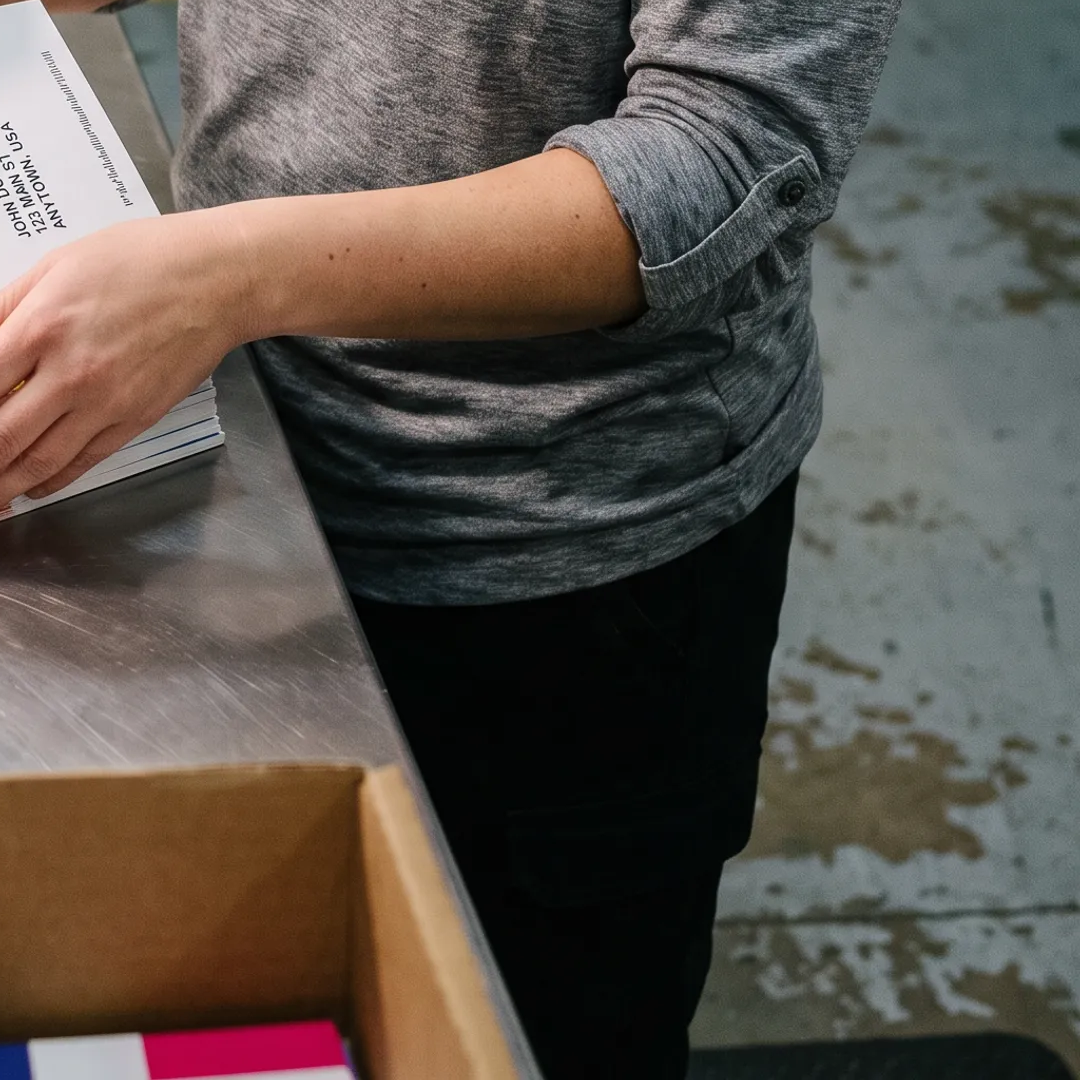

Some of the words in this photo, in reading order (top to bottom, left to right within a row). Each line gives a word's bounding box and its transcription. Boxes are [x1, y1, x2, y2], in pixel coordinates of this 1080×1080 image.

[0, 121, 23, 151] USA
[8, 173, 35, 208] MAIN
[19, 154, 66, 228] ANYTOWN,
[2, 201, 31, 237] JOHN
[27, 210, 47, 233] 123
